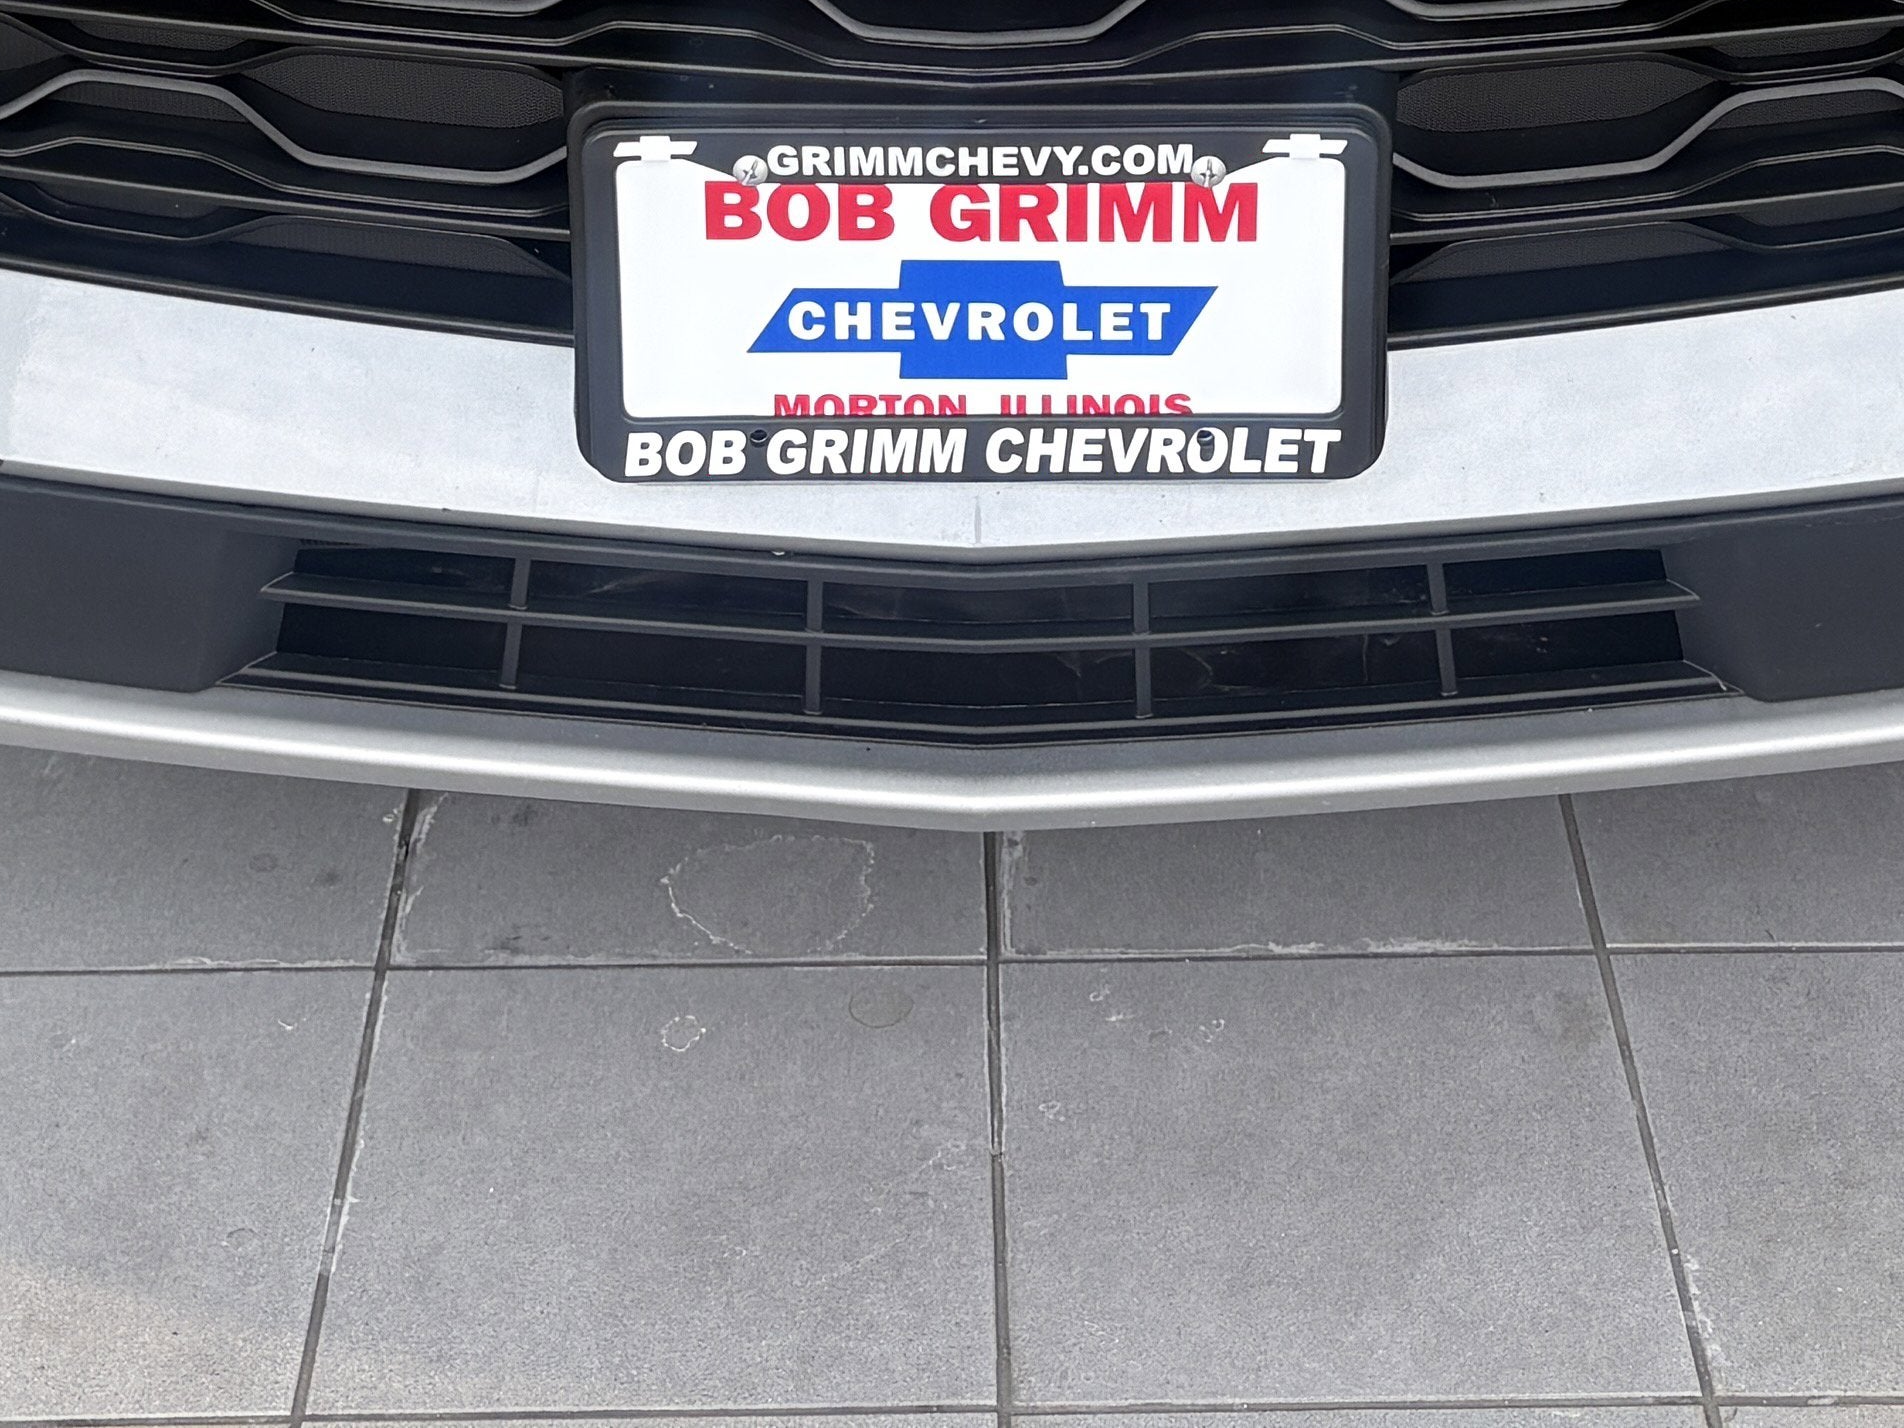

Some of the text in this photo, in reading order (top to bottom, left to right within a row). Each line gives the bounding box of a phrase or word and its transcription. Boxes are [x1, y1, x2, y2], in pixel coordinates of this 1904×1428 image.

[766, 143, 1195, 179] GRIMMCHEVY.COM
[705, 182, 1258, 243] BOB GRIMM
[787, 300, 1172, 342] CHEVROLET
[624, 428, 1342, 478] BOB GRIMM CHEVROLET
